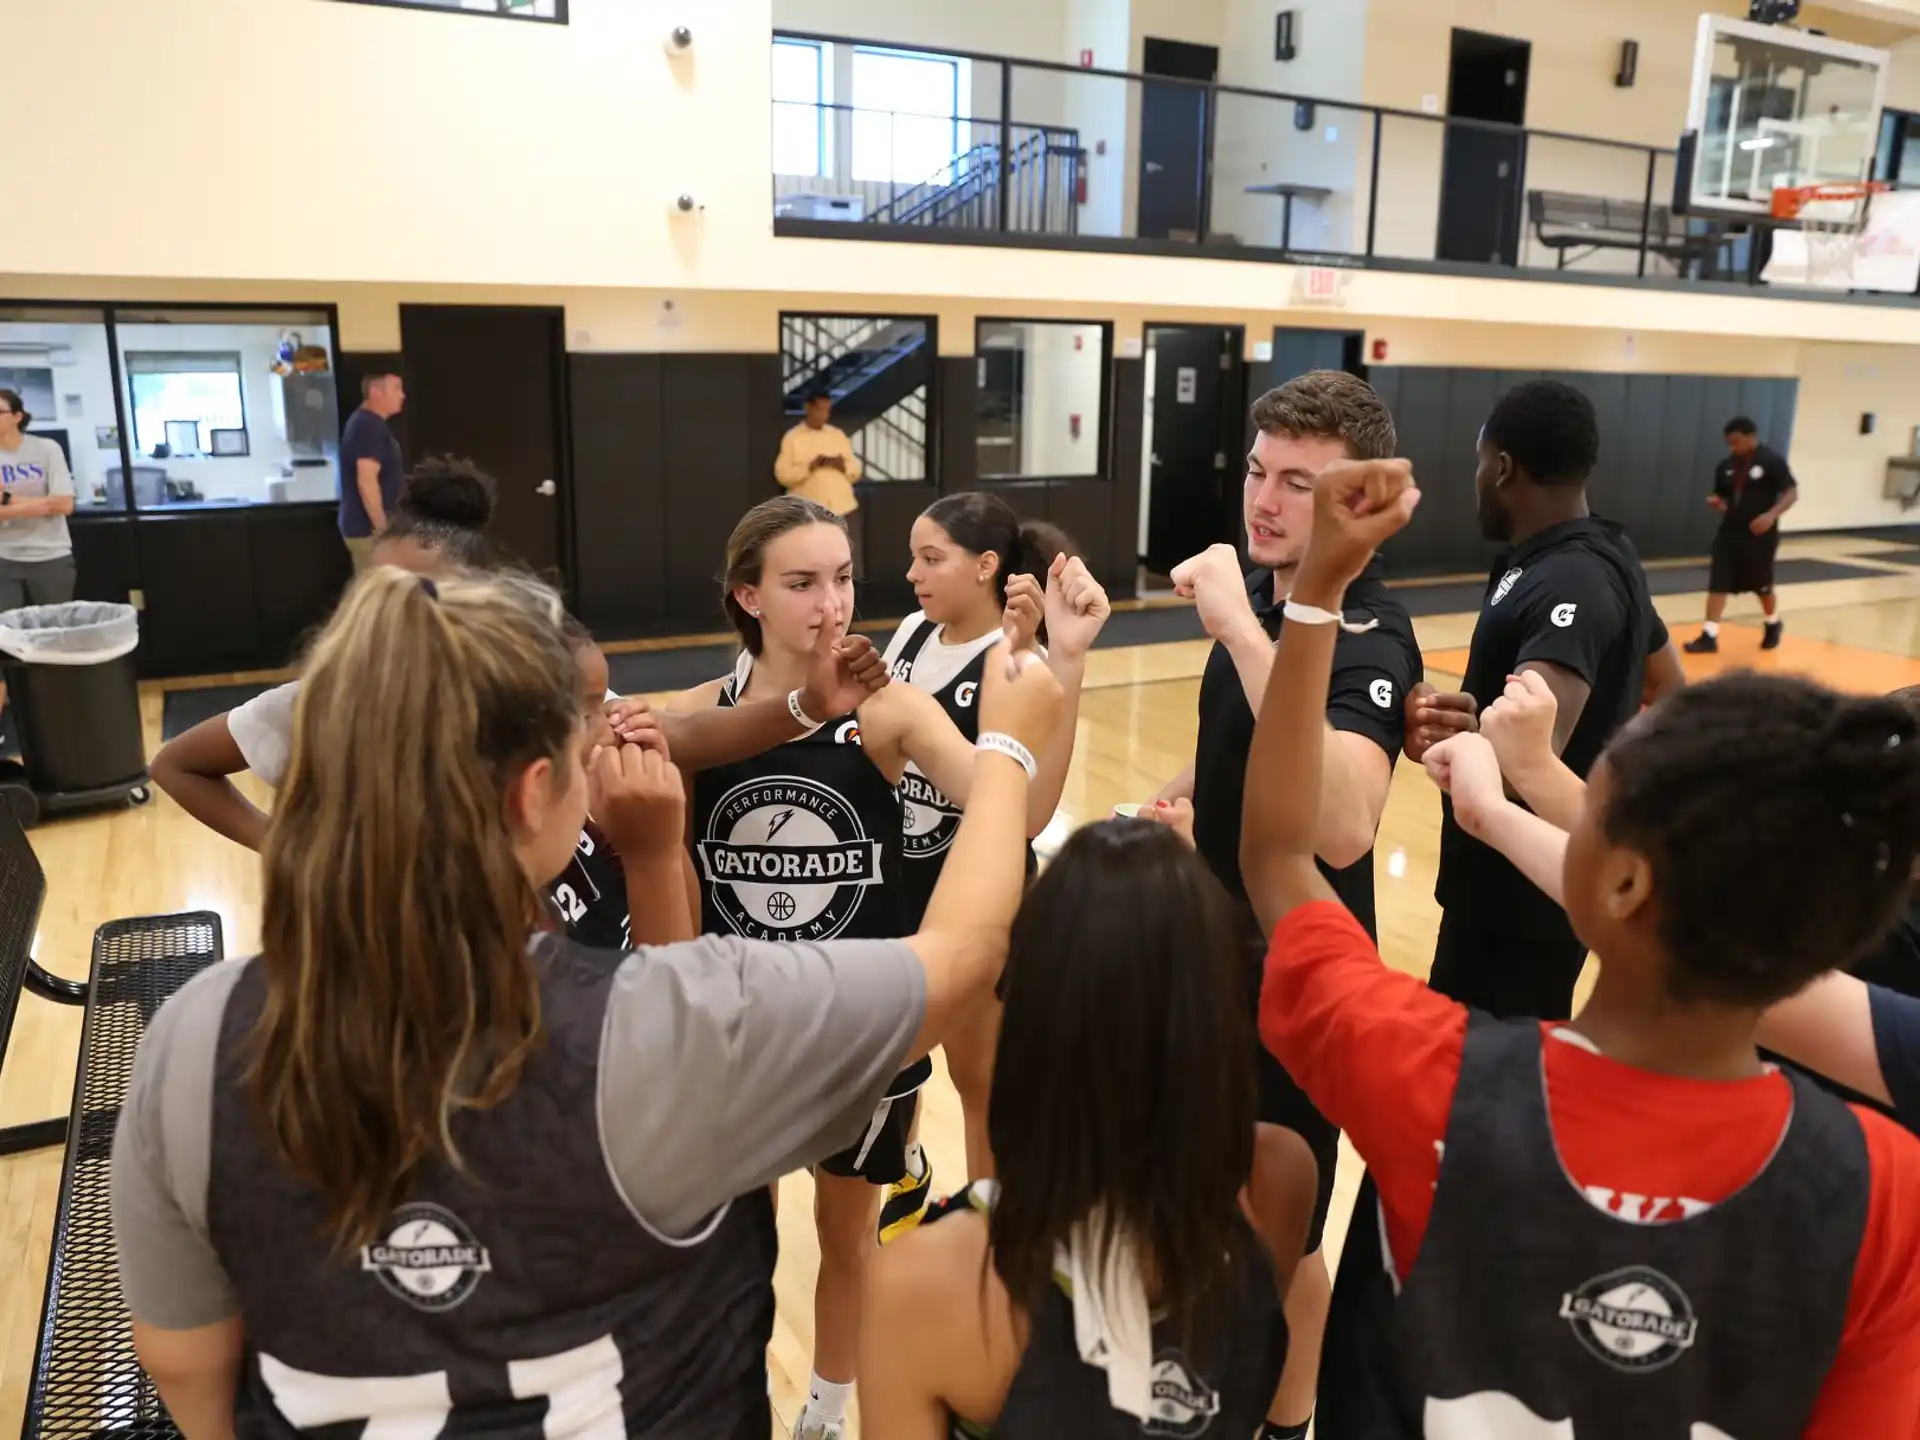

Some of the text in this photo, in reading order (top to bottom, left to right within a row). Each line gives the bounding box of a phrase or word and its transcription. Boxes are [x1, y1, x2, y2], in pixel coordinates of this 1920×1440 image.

[954, 681, 978, 707] G
[726, 788, 838, 821] PERFORMANCE
[714, 849, 863, 878] GATORADE
[735, 910, 838, 942] ACADEMY
[372, 1246, 479, 1267] GATORADE
[1574, 1298, 1689, 1339] GATORADE
